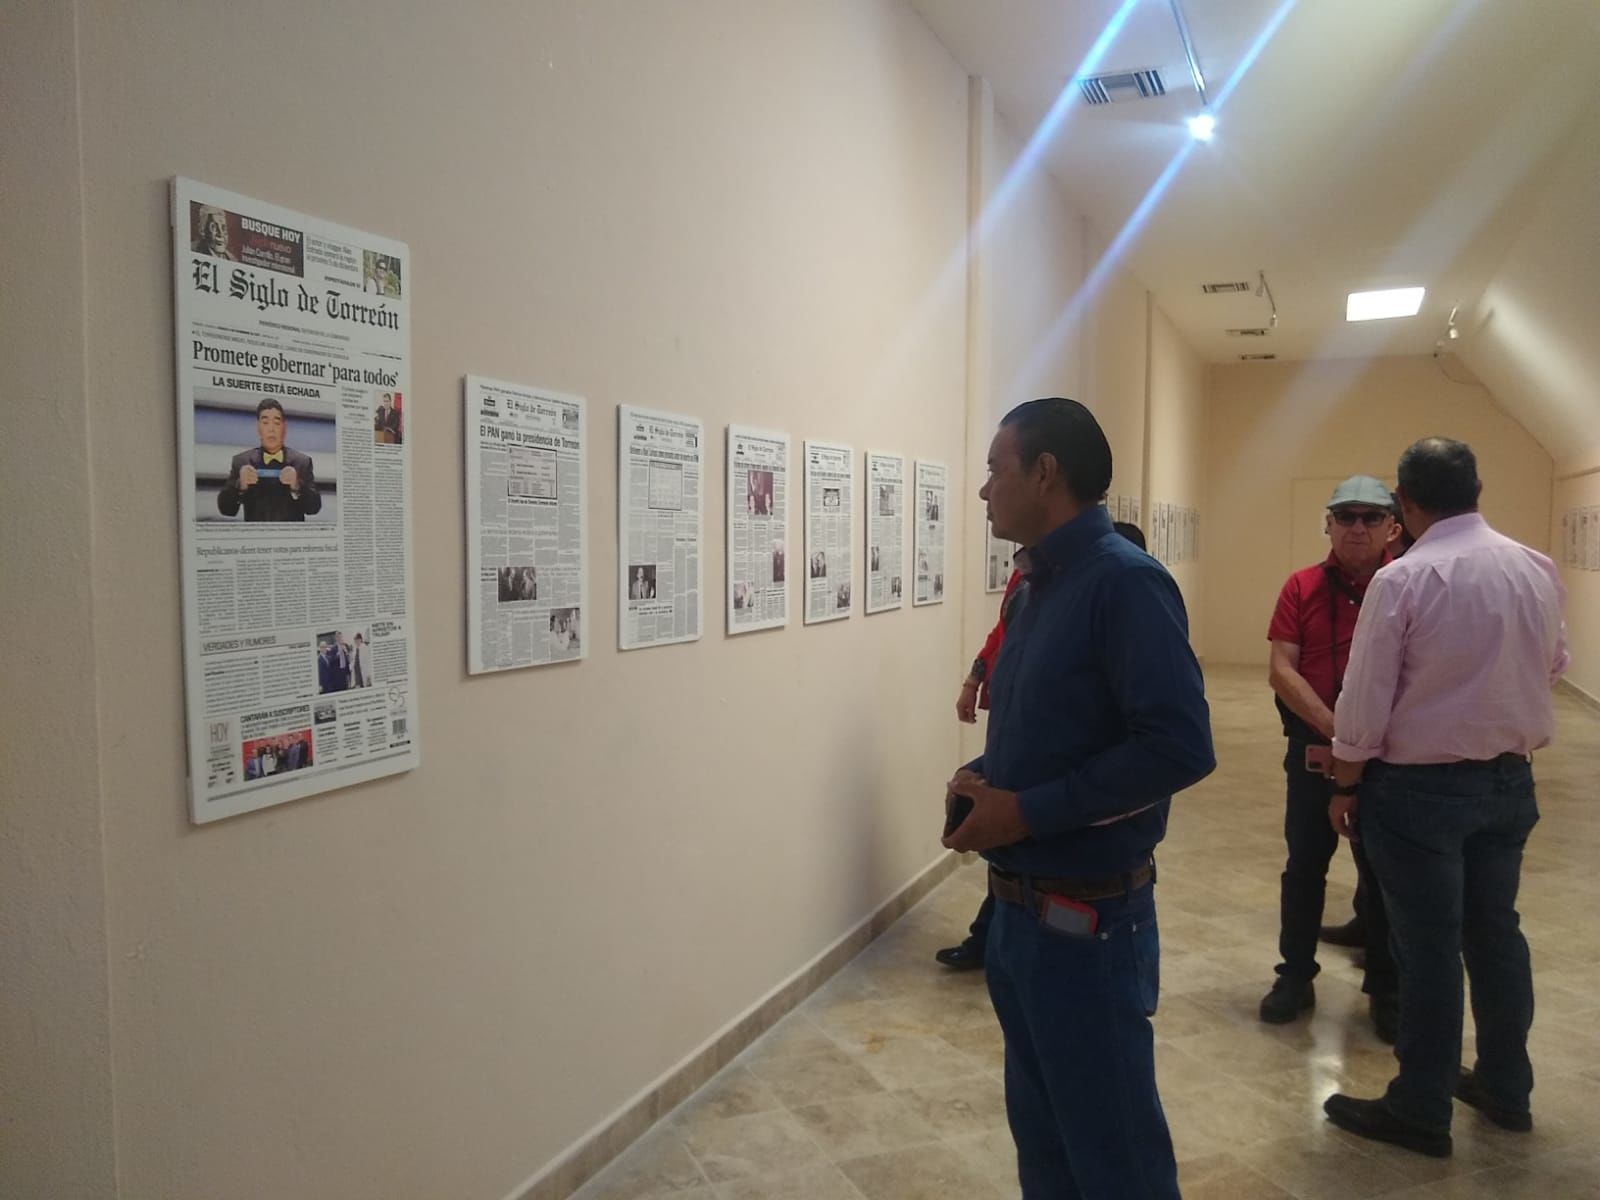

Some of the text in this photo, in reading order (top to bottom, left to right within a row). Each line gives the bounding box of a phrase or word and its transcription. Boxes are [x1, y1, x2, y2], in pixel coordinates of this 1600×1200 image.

[241, 216, 301, 244] BUSQUE HOY
[192, 258, 220, 295] El
[229, 268, 290, 311] Siglo
[297, 284, 320, 315] de
[325, 290, 400, 330] Torreón
[192, 340, 258, 368] Promete
[261, 352, 326, 378] gobernar
[212, 376, 321, 398] LA SUERTE ESTÁ ECHADA
[487, 426, 500, 439] PAN
[203, 639, 239, 652] VERDADES
[245, 635, 277, 647] RUMORES
[209, 721, 229, 744] HOY
